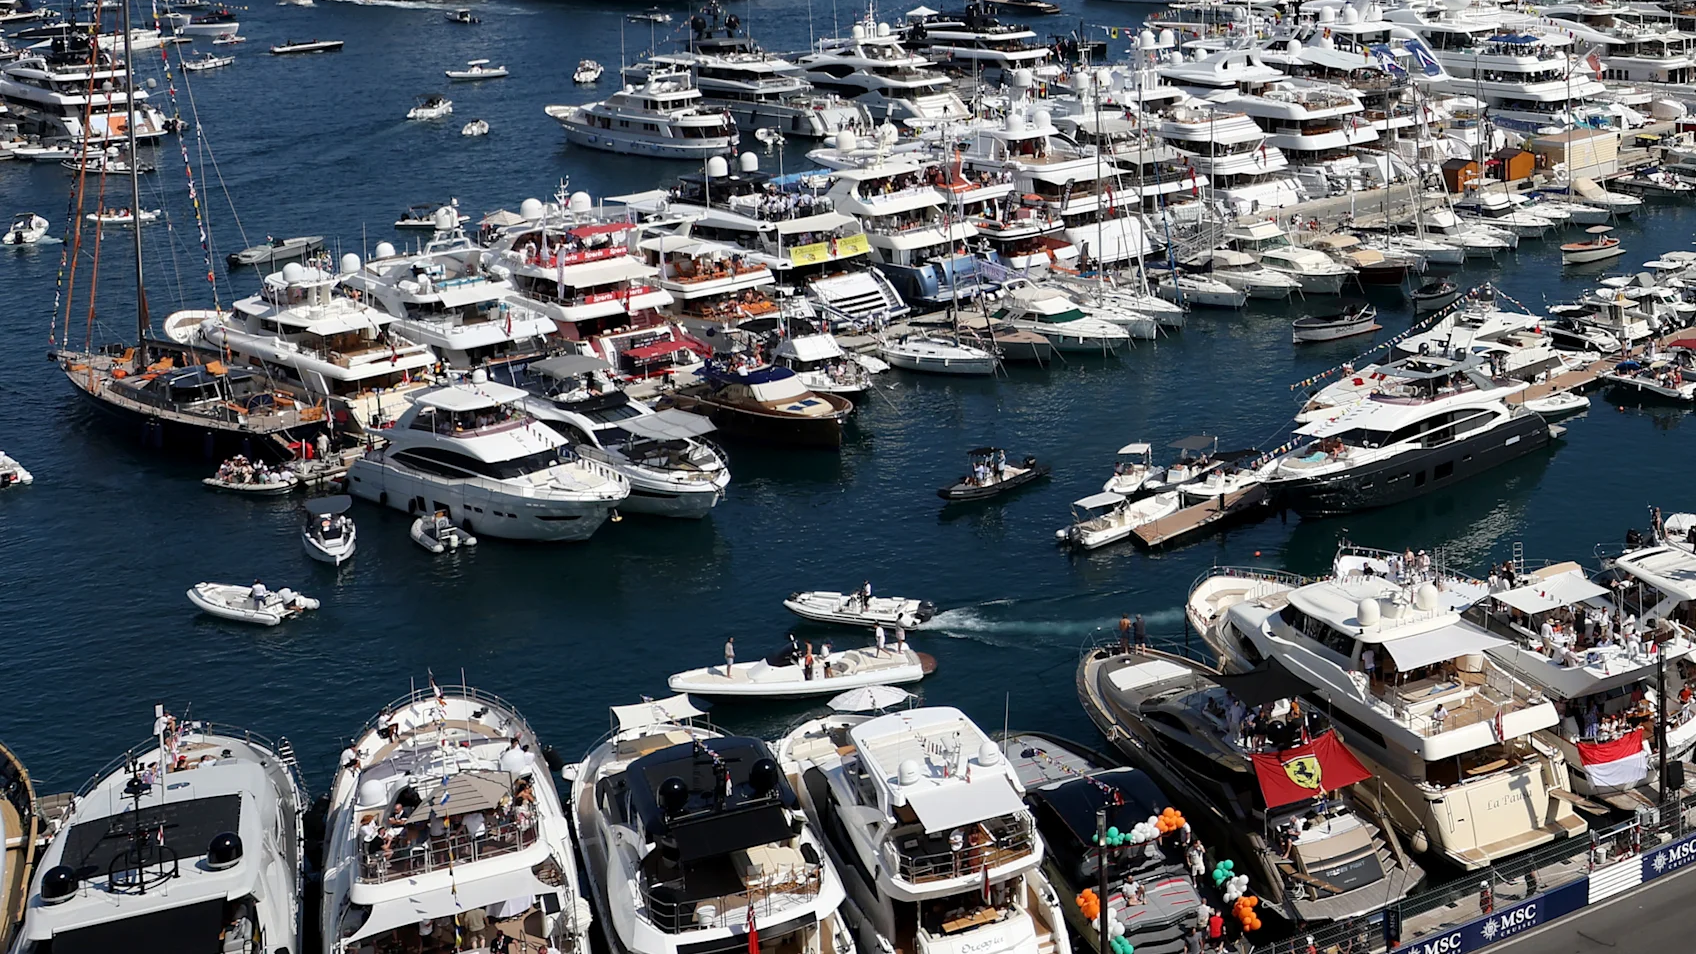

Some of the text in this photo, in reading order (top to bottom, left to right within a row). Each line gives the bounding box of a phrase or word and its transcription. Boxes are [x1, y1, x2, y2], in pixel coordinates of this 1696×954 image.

[584, 250, 603, 259] Sports
[609, 247, 627, 256] Sports
[594, 292, 613, 302] Sports
[1501, 904, 1537, 930] MSC
[1424, 933, 1462, 954] MSC
